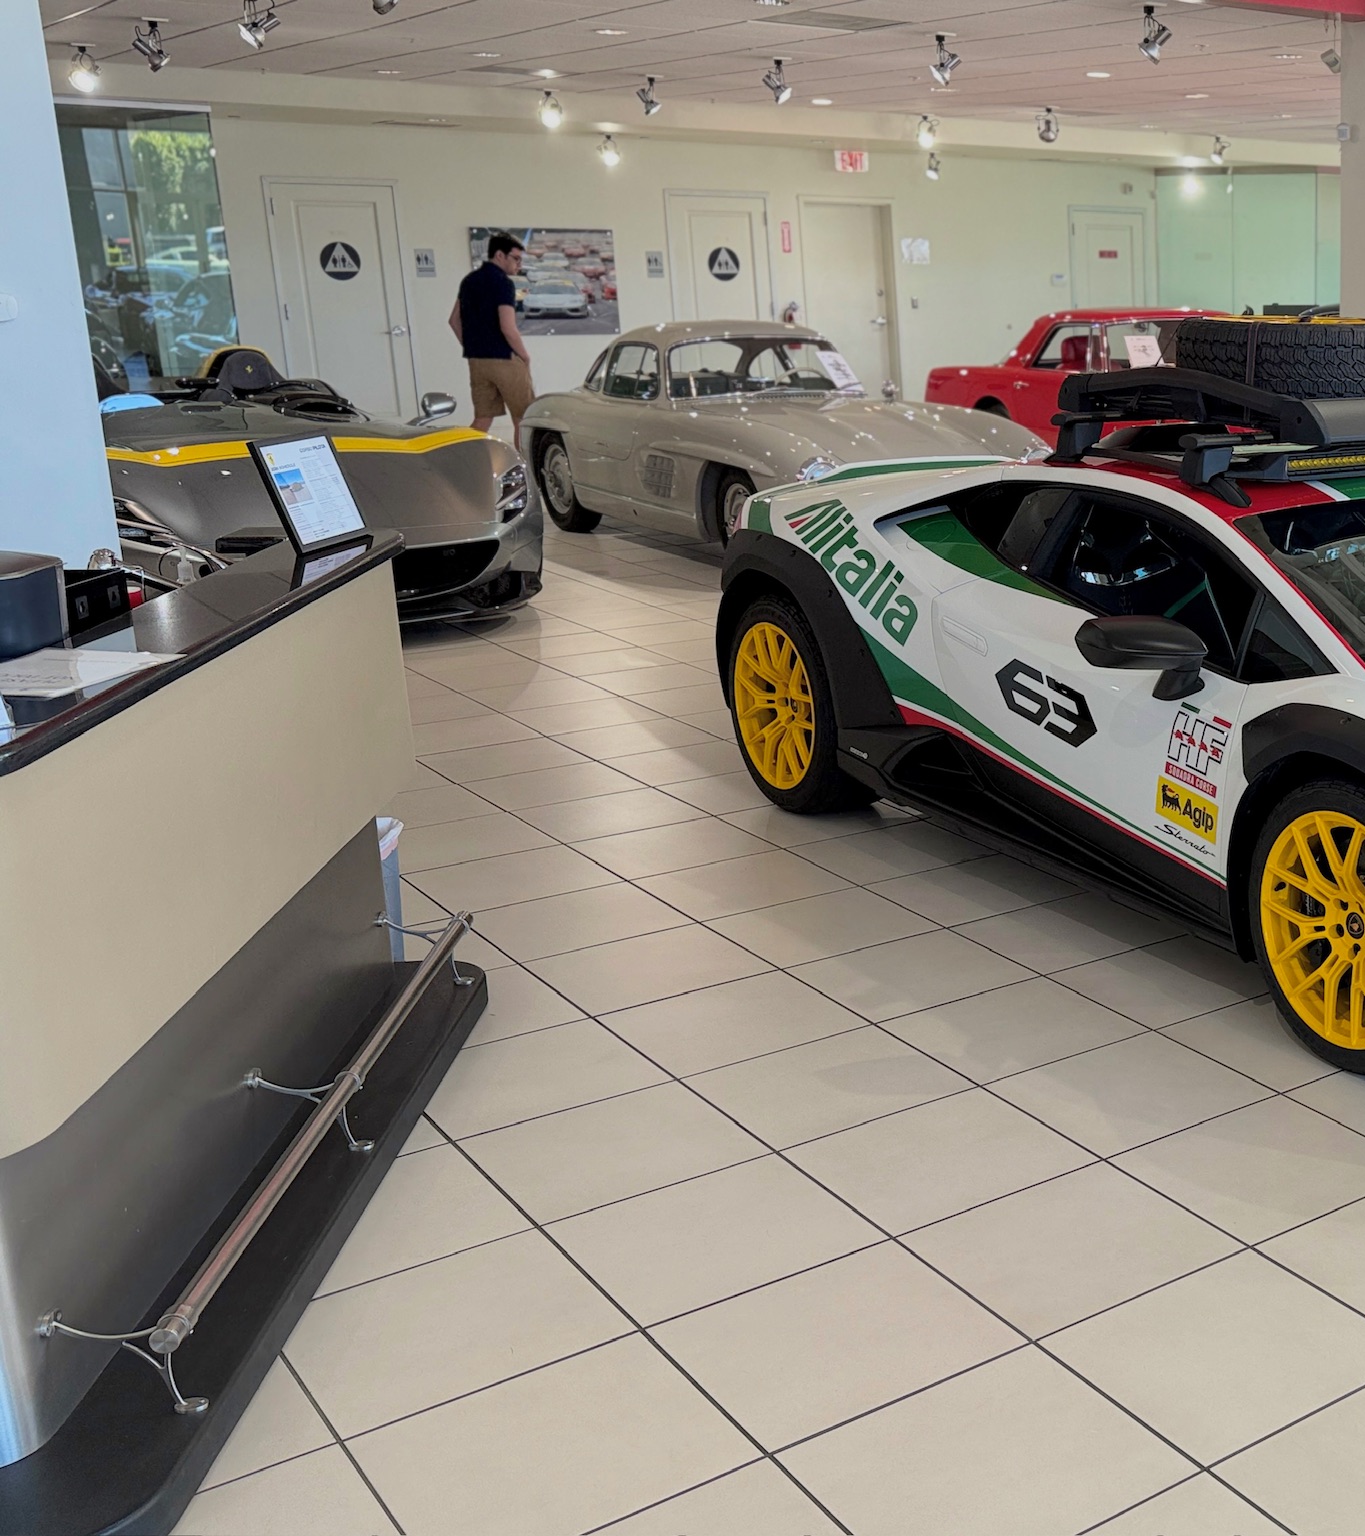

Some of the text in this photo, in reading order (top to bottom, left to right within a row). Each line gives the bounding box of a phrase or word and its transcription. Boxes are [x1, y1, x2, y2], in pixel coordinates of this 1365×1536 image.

[841, 151, 864, 170] EXIT
[784, 499, 918, 646] Alitalia
[995, 658, 1098, 748] 63
[1167, 710, 1229, 776] HF
[1168, 765, 1214, 796] SQUADRA CORSE
[1182, 799, 1214, 834] Agip
[1154, 823, 1216, 857] Sterrato
